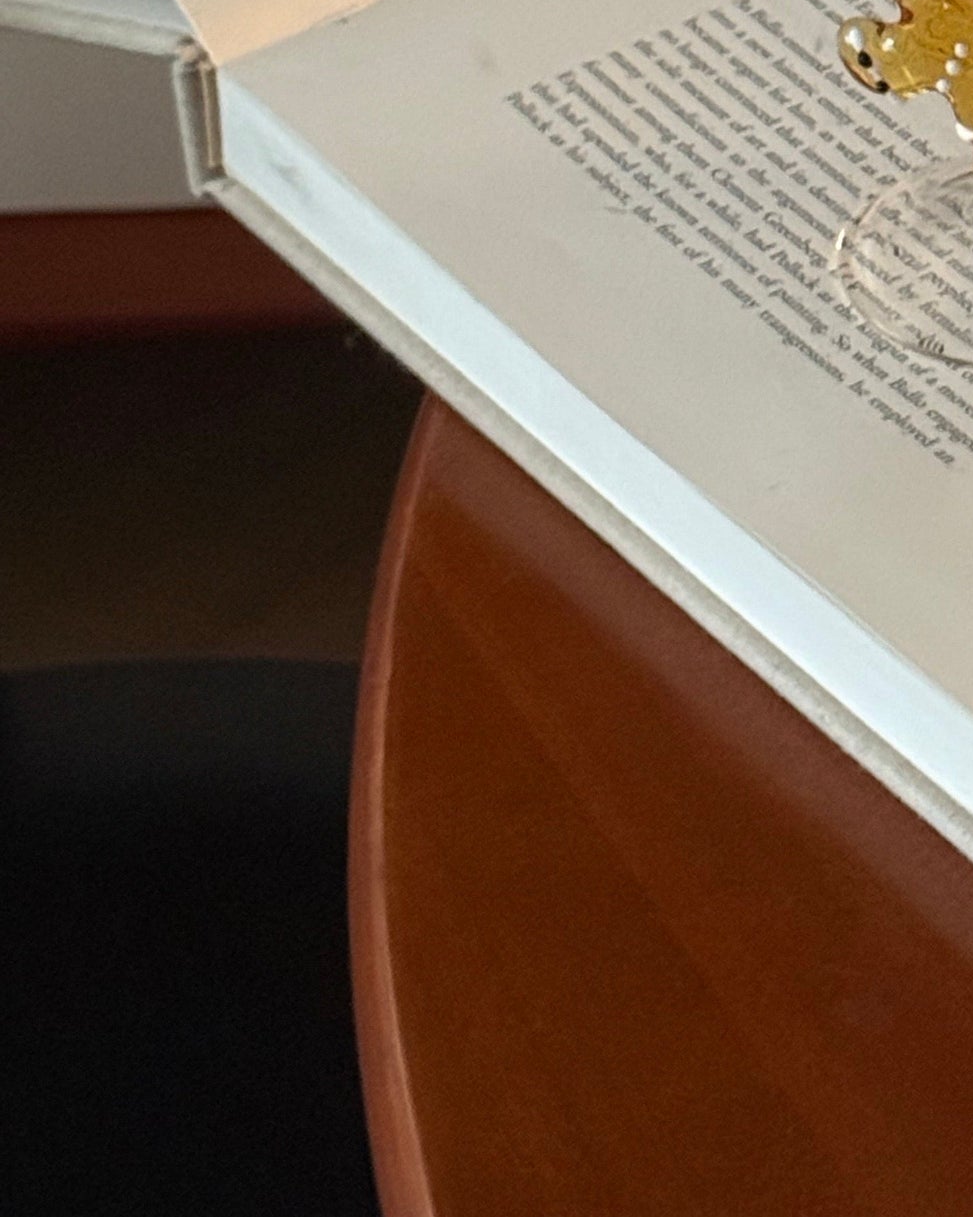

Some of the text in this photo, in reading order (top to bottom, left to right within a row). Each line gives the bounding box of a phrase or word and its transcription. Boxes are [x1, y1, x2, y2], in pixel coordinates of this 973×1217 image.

[734, 30, 748, 38] a
[822, 70, 850, 89] the
[726, 119, 754, 134] of
[744, 165, 772, 186] the
[554, 102, 591, 127] had
[631, 170, 660, 191] the
[753, 273, 783, 290] of
[830, 332, 855, 352] So
[850, 350, 892, 380] when
[693, 190, 709, 199] a
[742, 228, 779, 253] had
[768, 249, 825, 291] Pollock
[905, 361, 936, 379] of
[923, 375, 940, 385] a
[679, 246, 708, 262] of
[697, 258, 723, 278] his
[718, 277, 762, 312] many
[865, 396, 941, 448] employed
[932, 448, 957, 465] an
